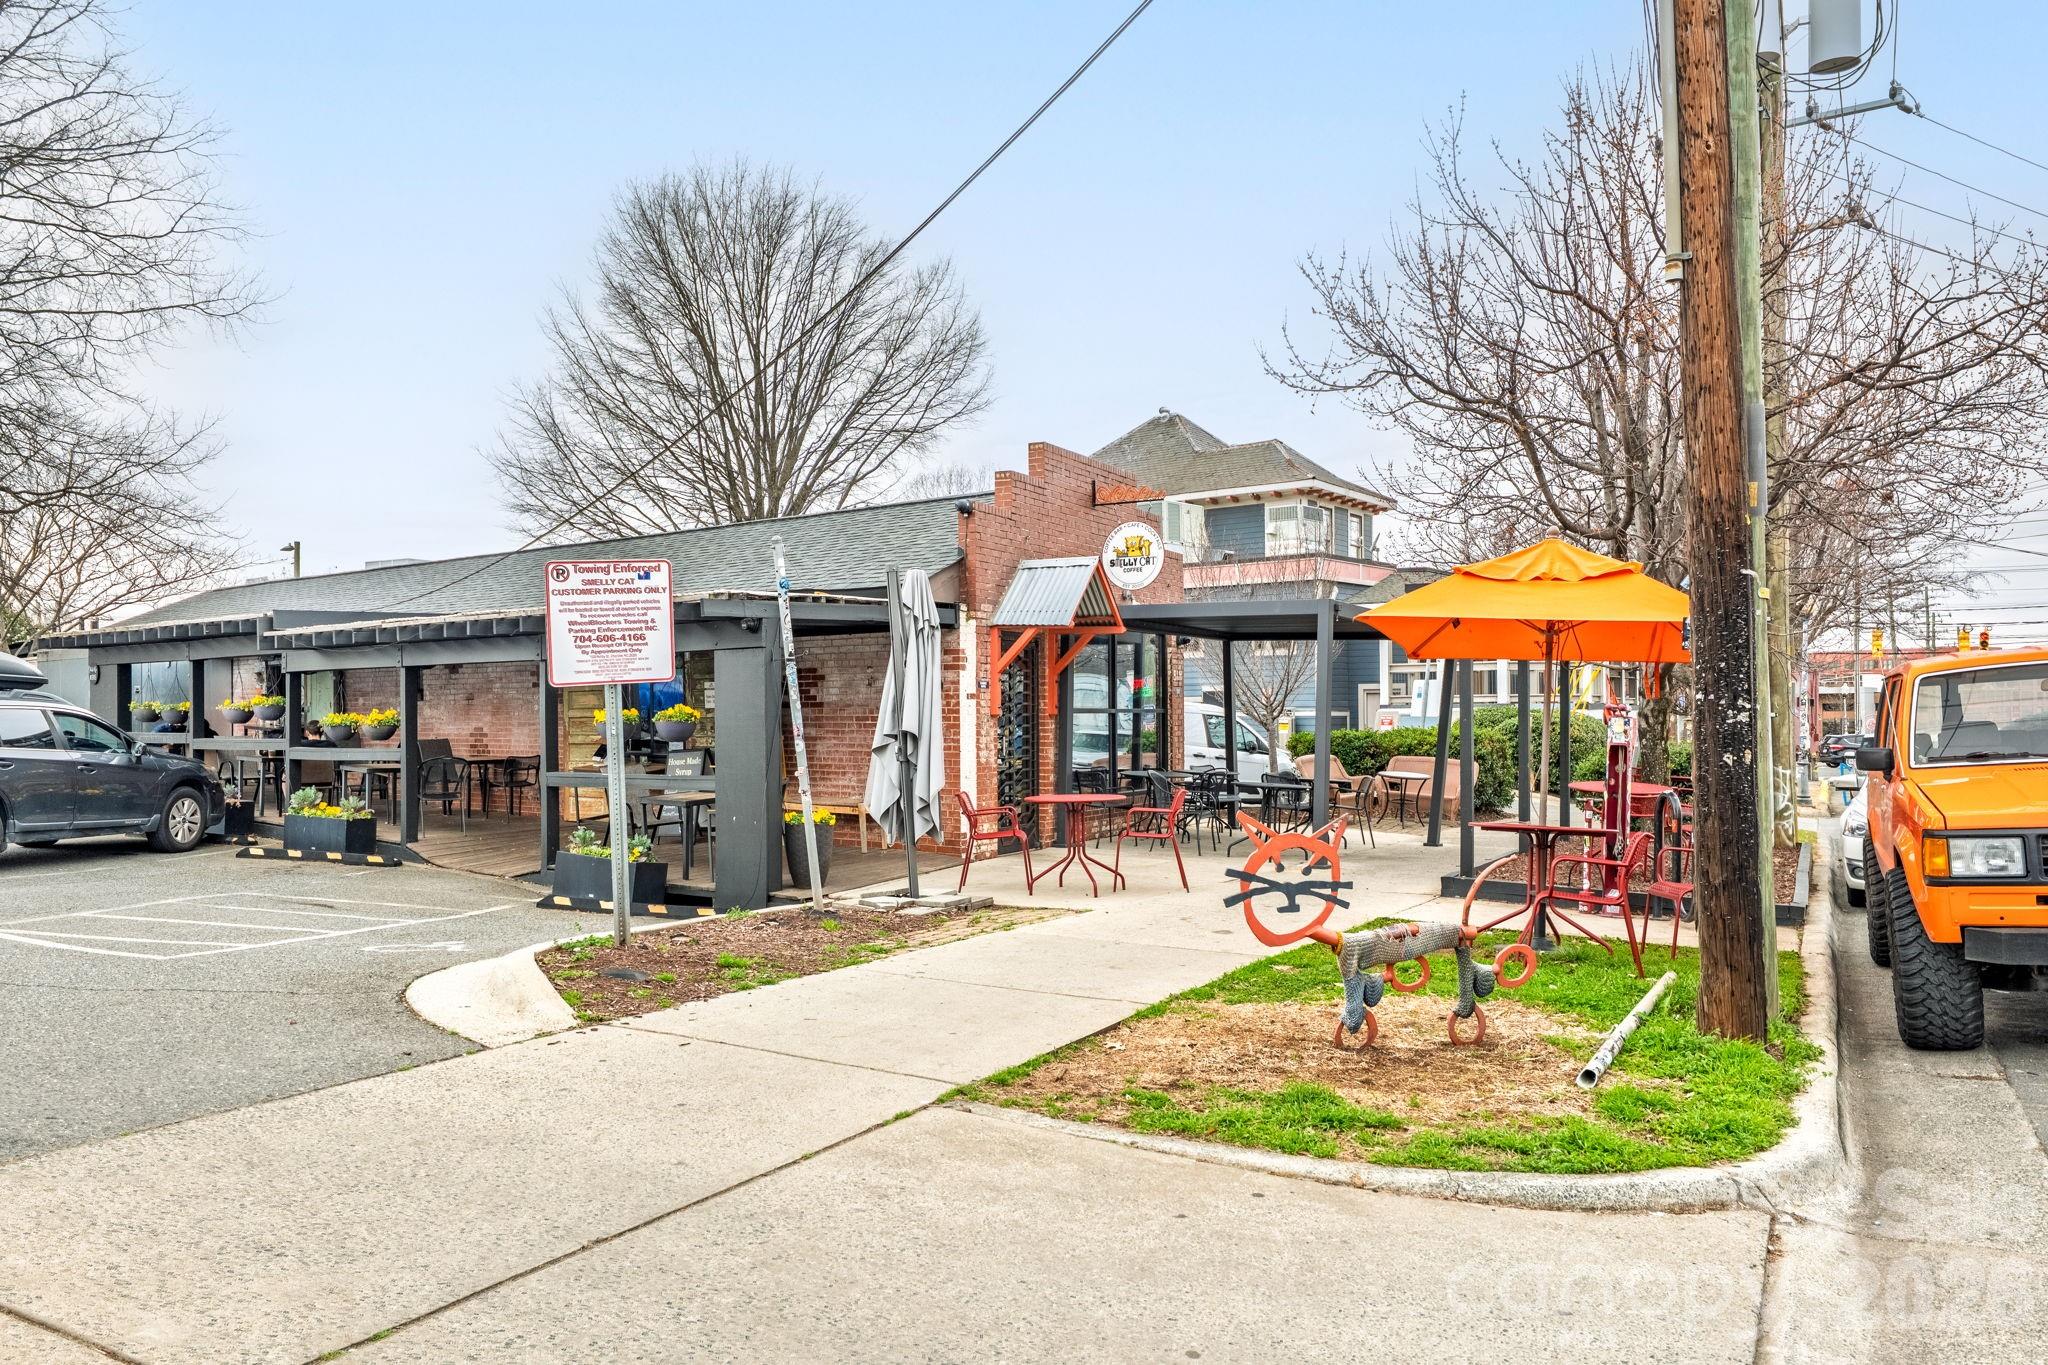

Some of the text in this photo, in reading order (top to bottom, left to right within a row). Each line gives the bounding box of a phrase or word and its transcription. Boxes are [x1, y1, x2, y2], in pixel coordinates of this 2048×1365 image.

[1139, 556, 1157, 567] CAT
[572, 563, 661, 576] Towing Enforced
[551, 586, 667, 596] CUSTOMER PARKING ONLY
[567, 619, 622, 627] WheelBlockers
[568, 627, 596, 635] Parking
[572, 633, 647, 643] 704-606-4166
[668, 756, 702, 766] House Made
[675, 768, 693, 776] Syrup
